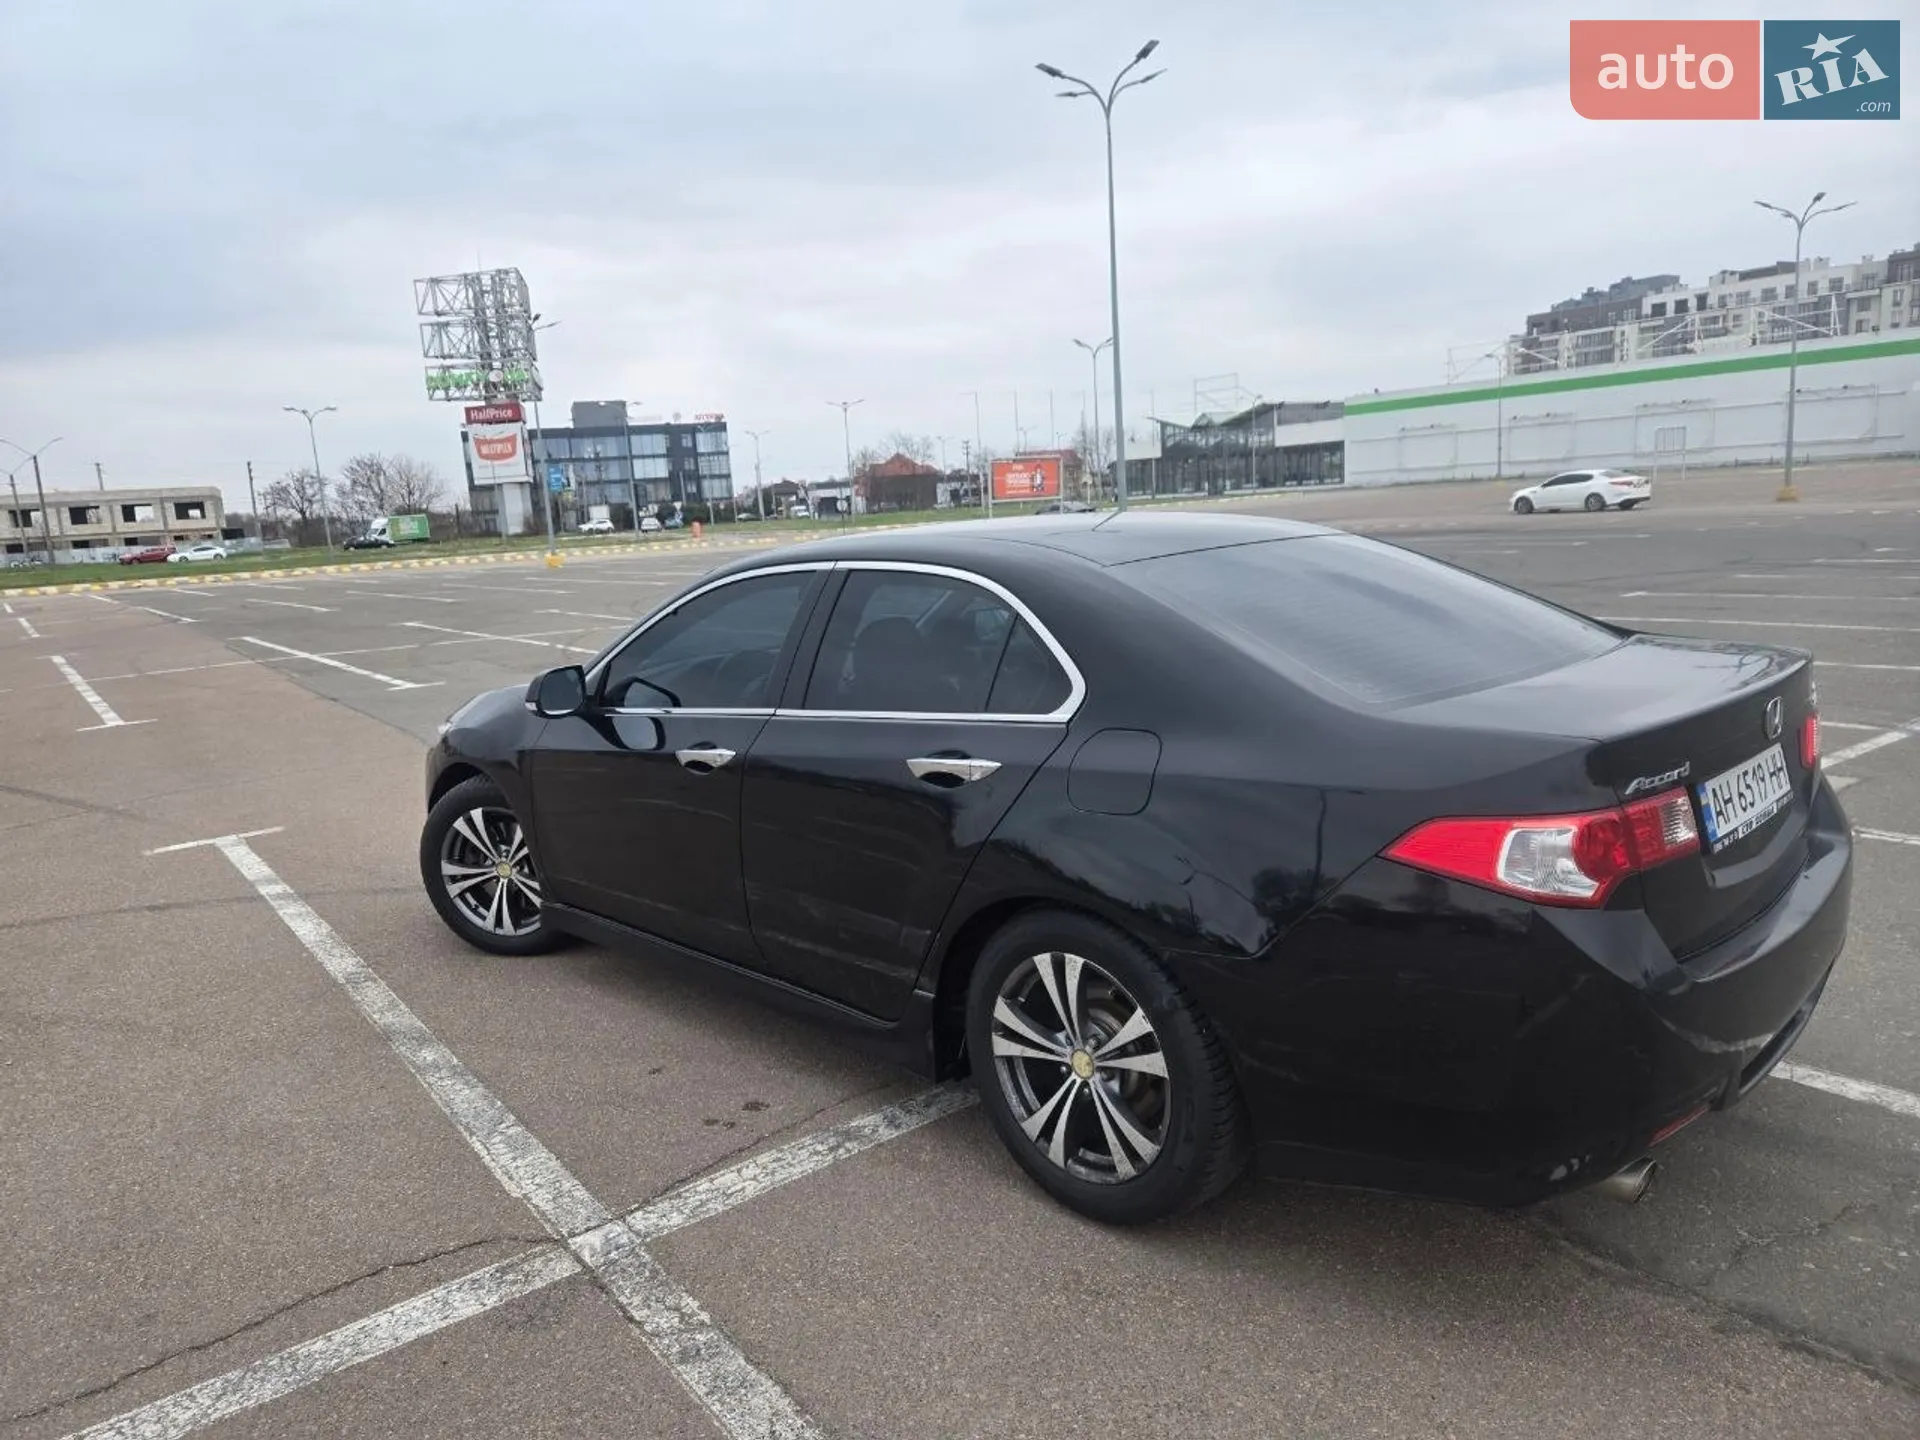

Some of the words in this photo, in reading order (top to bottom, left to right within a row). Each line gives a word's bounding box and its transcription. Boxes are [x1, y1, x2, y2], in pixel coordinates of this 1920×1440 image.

[1624, 761, 1691, 795] Accord
[1712, 780, 1736, 828] AH
[1736, 762, 1767, 812] 6519
